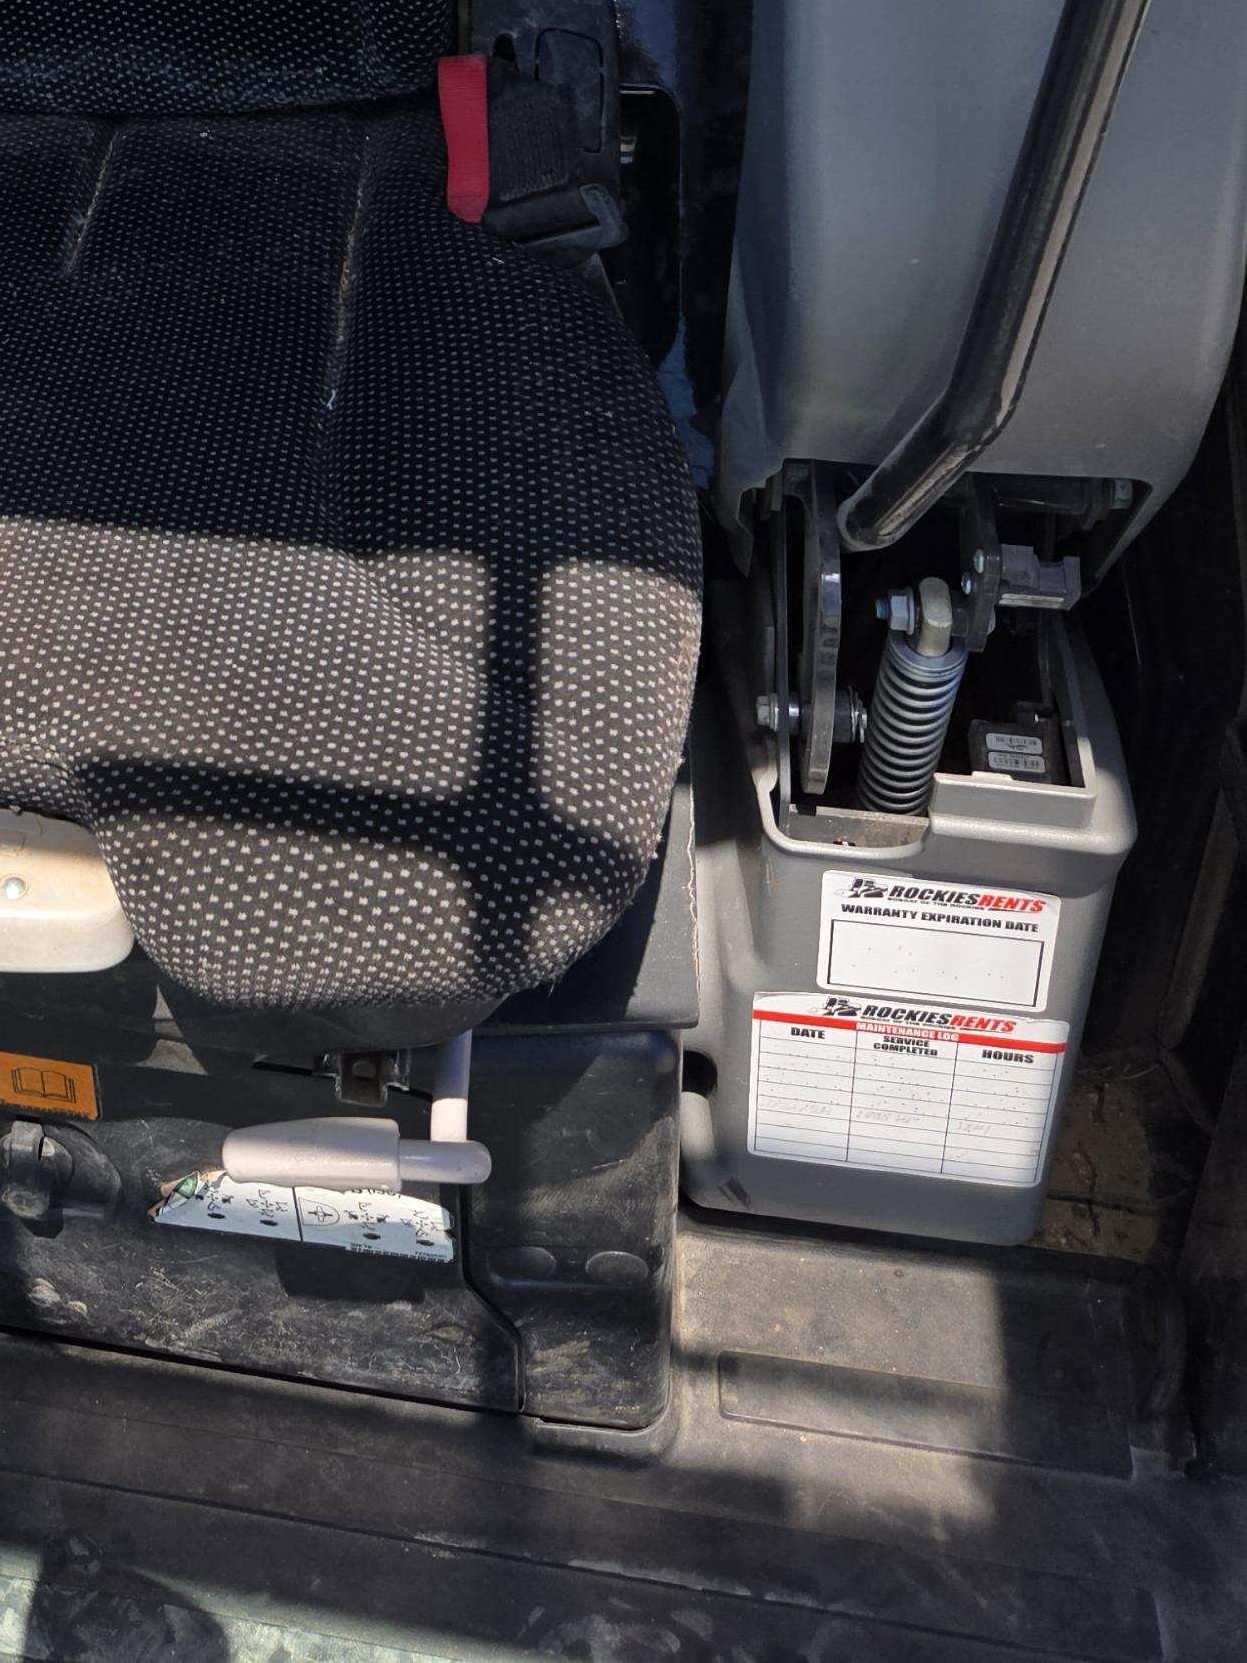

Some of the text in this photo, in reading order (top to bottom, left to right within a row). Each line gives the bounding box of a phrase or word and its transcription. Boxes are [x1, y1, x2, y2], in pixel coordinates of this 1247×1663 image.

[841, 904, 1039, 933] WARRANTY EXPIRATION DATE
[790, 1026, 825, 1040] DATE
[856, 1022, 959, 1041] MAINTENANCE LOG
[883, 1036, 930, 1047] SERVICE
[873, 1043, 938, 1056] COMPLETED
[982, 1049, 1034, 1063] HOURS
